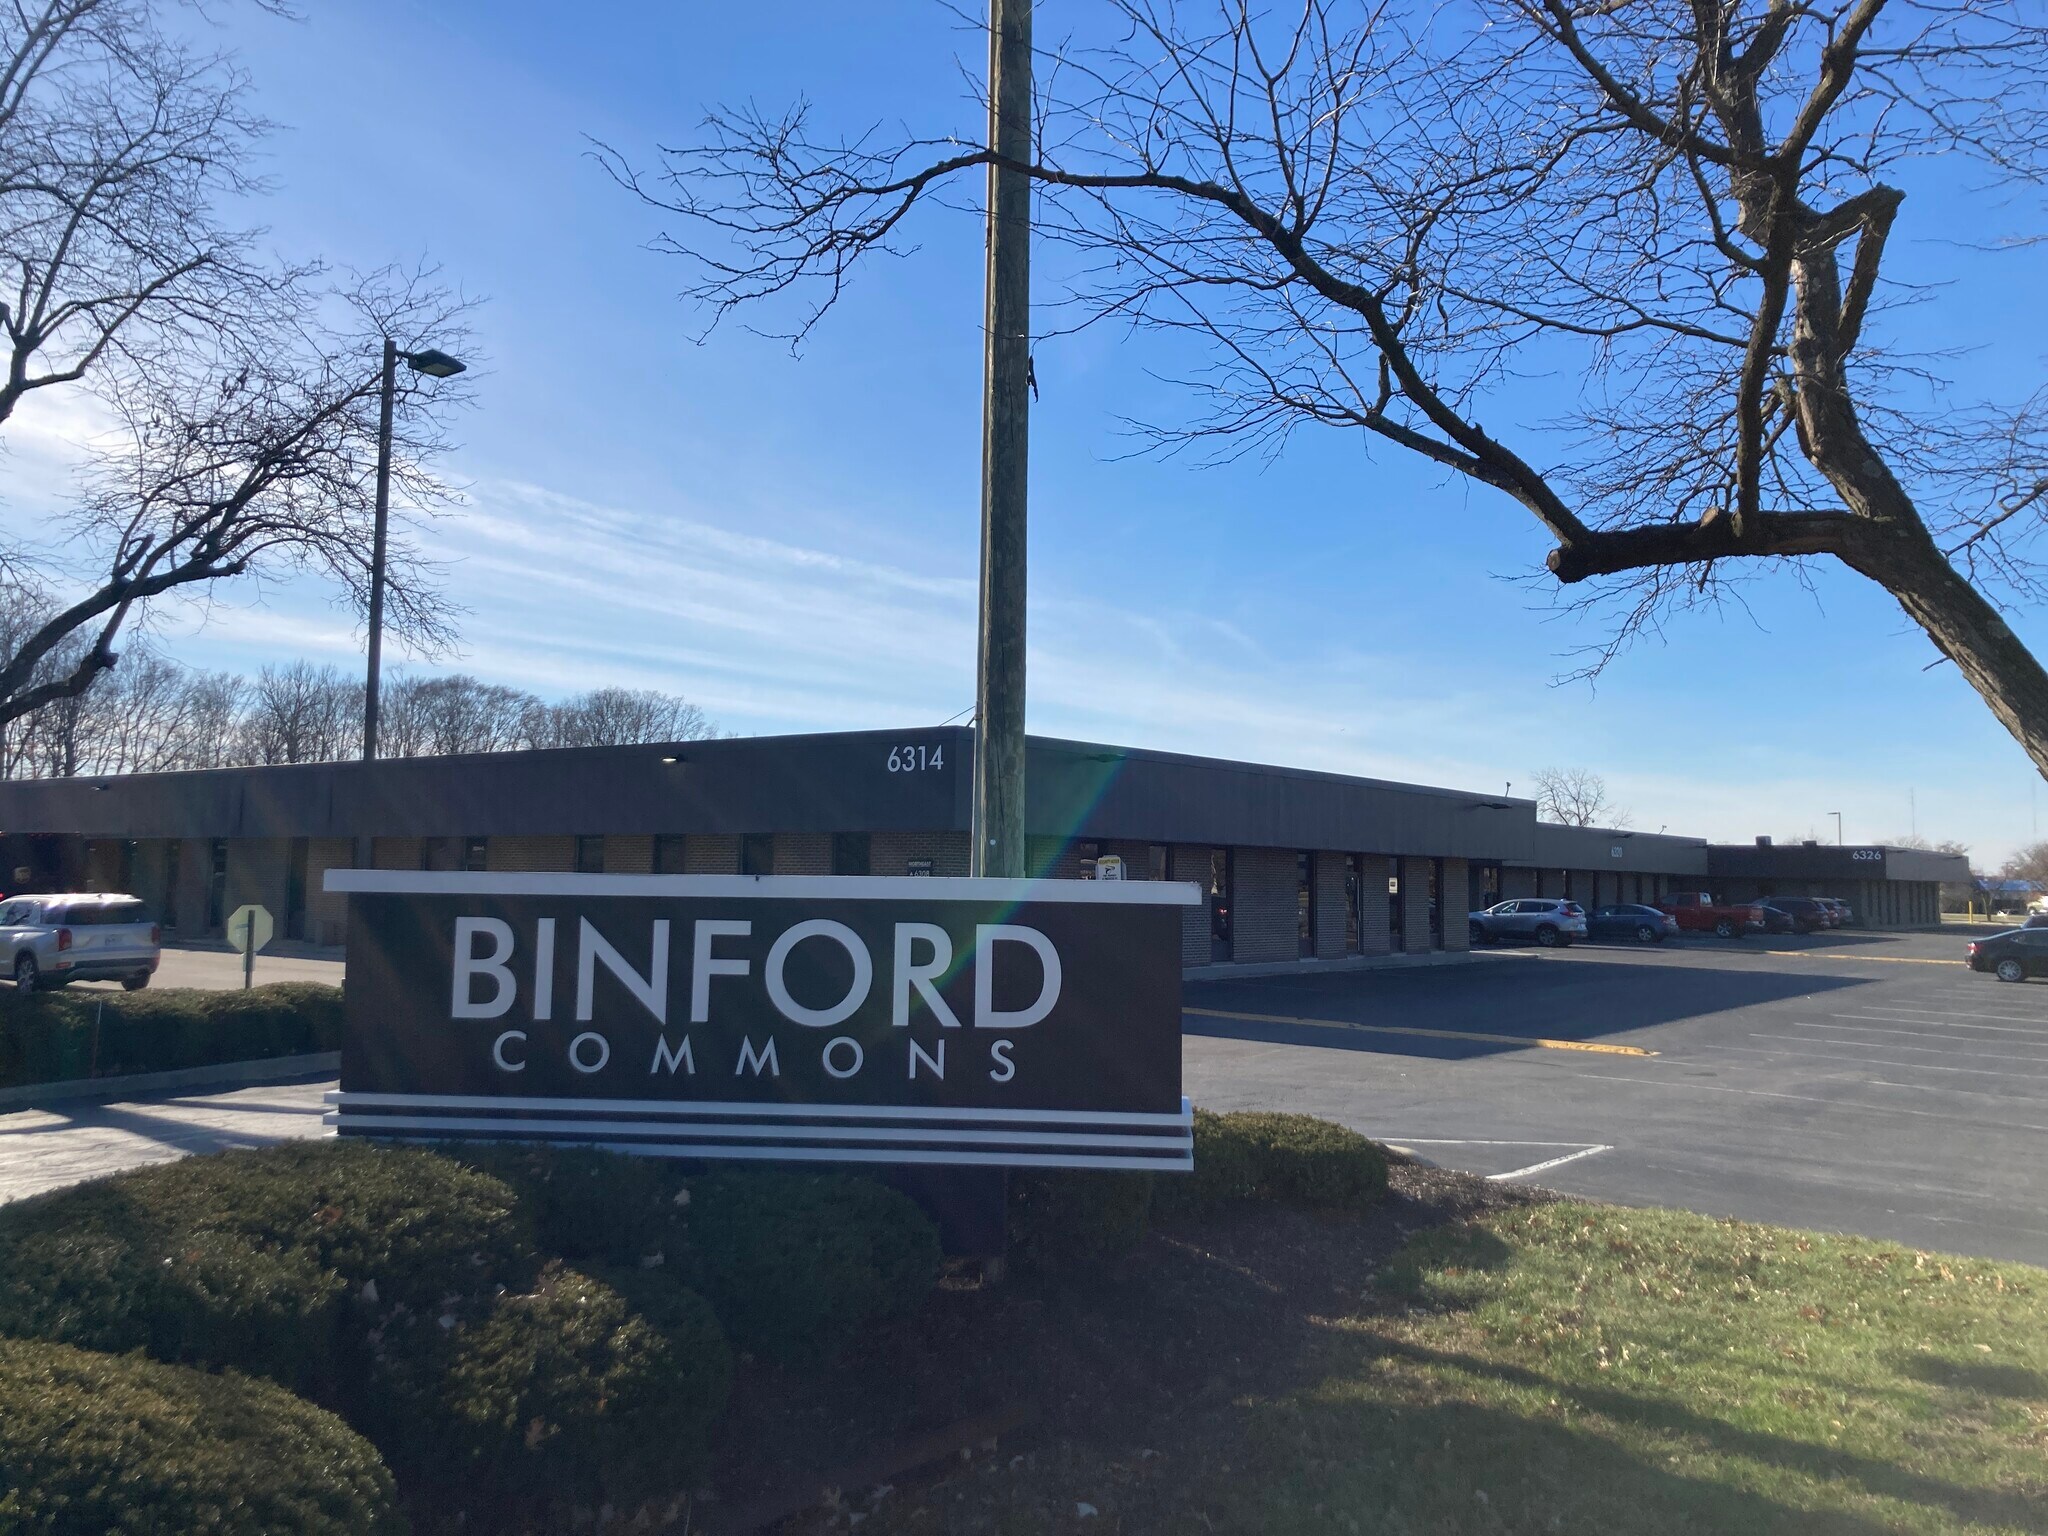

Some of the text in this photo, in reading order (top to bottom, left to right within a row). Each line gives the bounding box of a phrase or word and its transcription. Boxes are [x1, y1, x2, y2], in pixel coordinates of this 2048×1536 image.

[887, 744, 944, 772] 6314
[1852, 850, 1881, 860] 6326
[450, 915, 1062, 1029] BINFORD
[493, 1030, 1016, 1083] COMMONS
